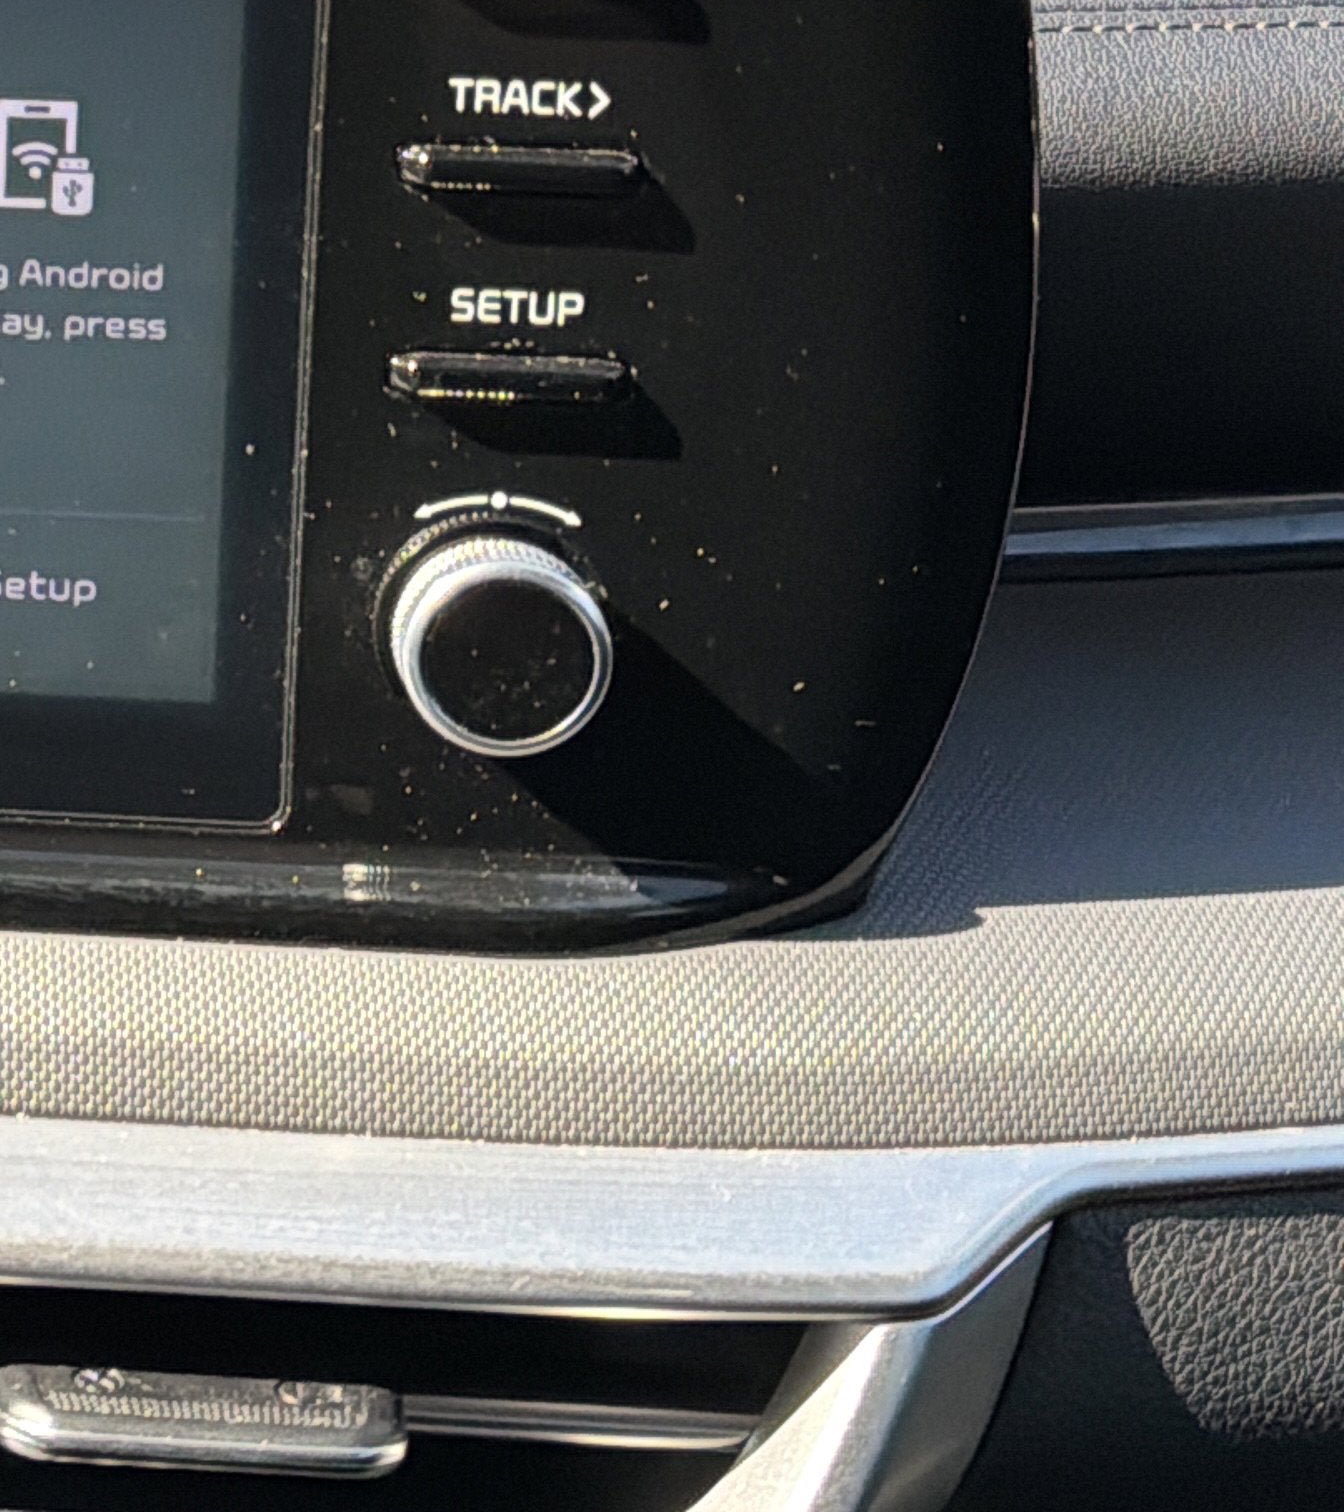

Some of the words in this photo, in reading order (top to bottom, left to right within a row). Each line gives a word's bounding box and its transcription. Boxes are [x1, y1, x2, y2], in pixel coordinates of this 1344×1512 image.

[20, 259, 163, 290] Android
[451, 288, 584, 326] SETUP
[64, 316, 166, 340] press
